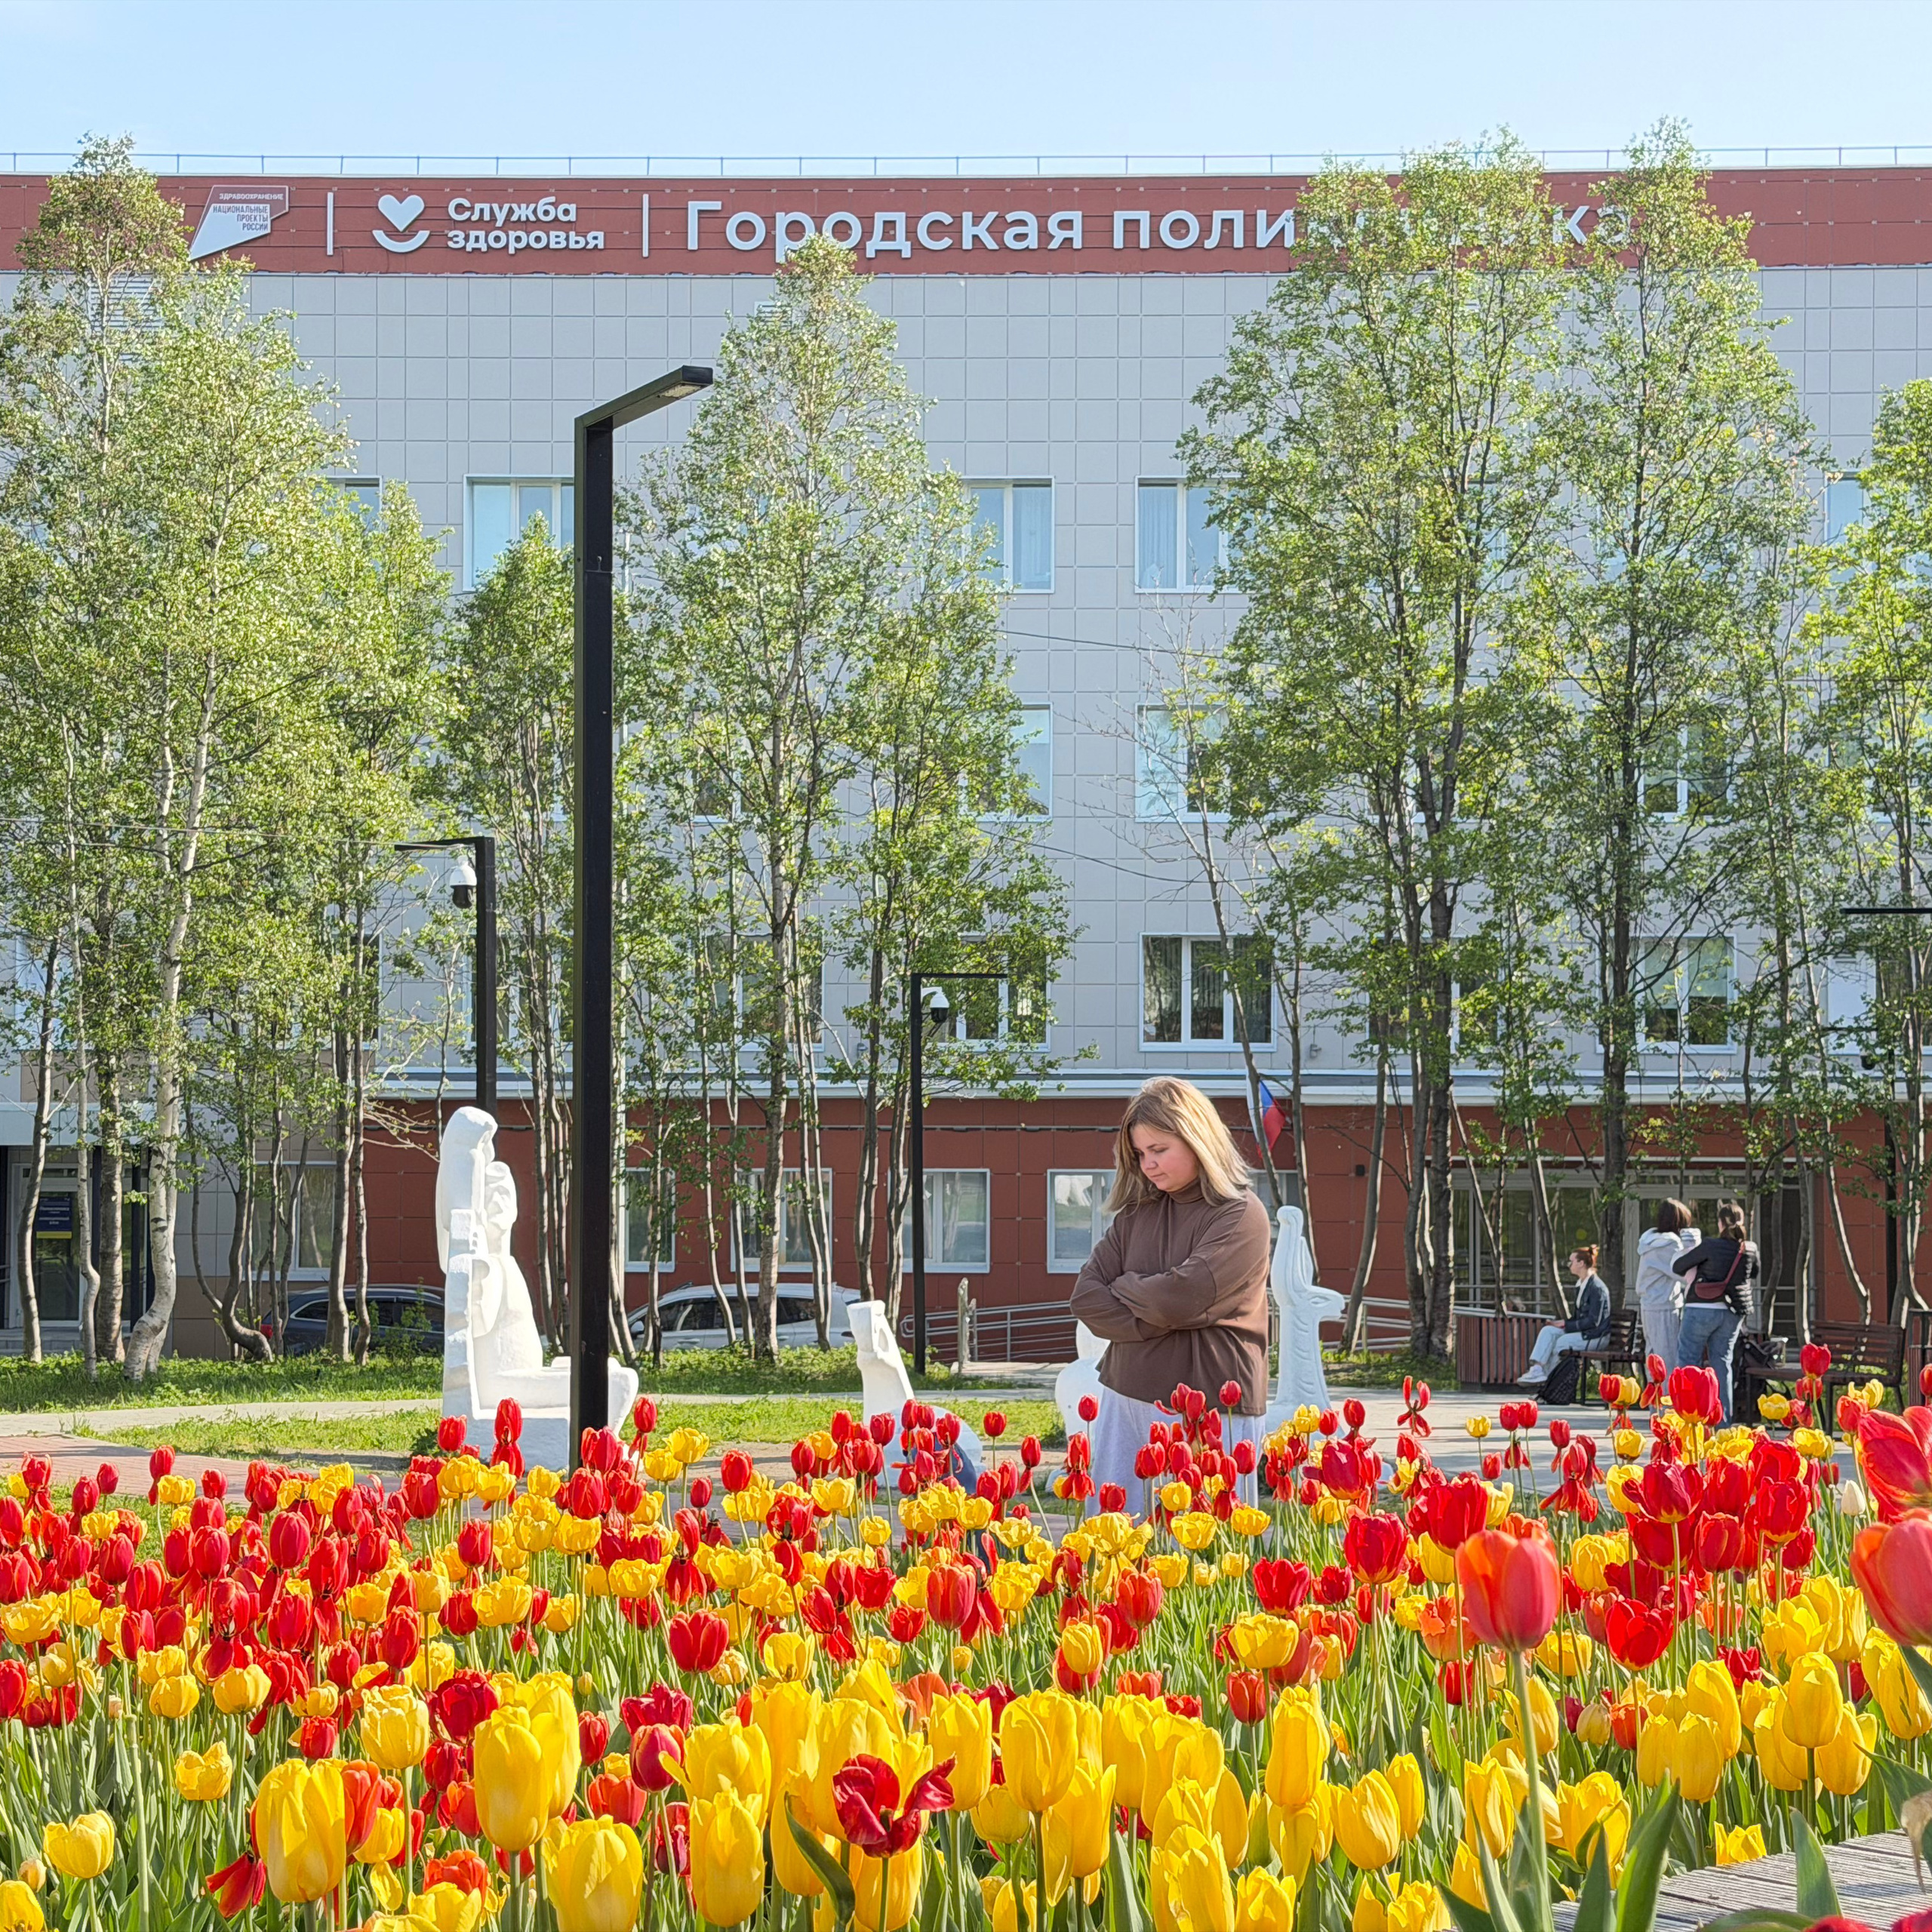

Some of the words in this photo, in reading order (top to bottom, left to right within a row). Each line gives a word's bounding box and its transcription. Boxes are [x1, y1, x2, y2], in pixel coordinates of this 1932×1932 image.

[219, 192, 284, 201] ЗДРАВООХРАНЕНИЕ
[213, 205, 268, 214] НАЦИОНАЛЬНЫЕ
[448, 196, 577, 227] Служба
[237, 214, 268, 222] ПРОЕКТЫ
[242, 223, 268, 231] РОССИИ
[688, 201, 1083, 263] Городская
[1113, 205, 1631, 250] полика
[447, 230, 605, 254] здоровья
